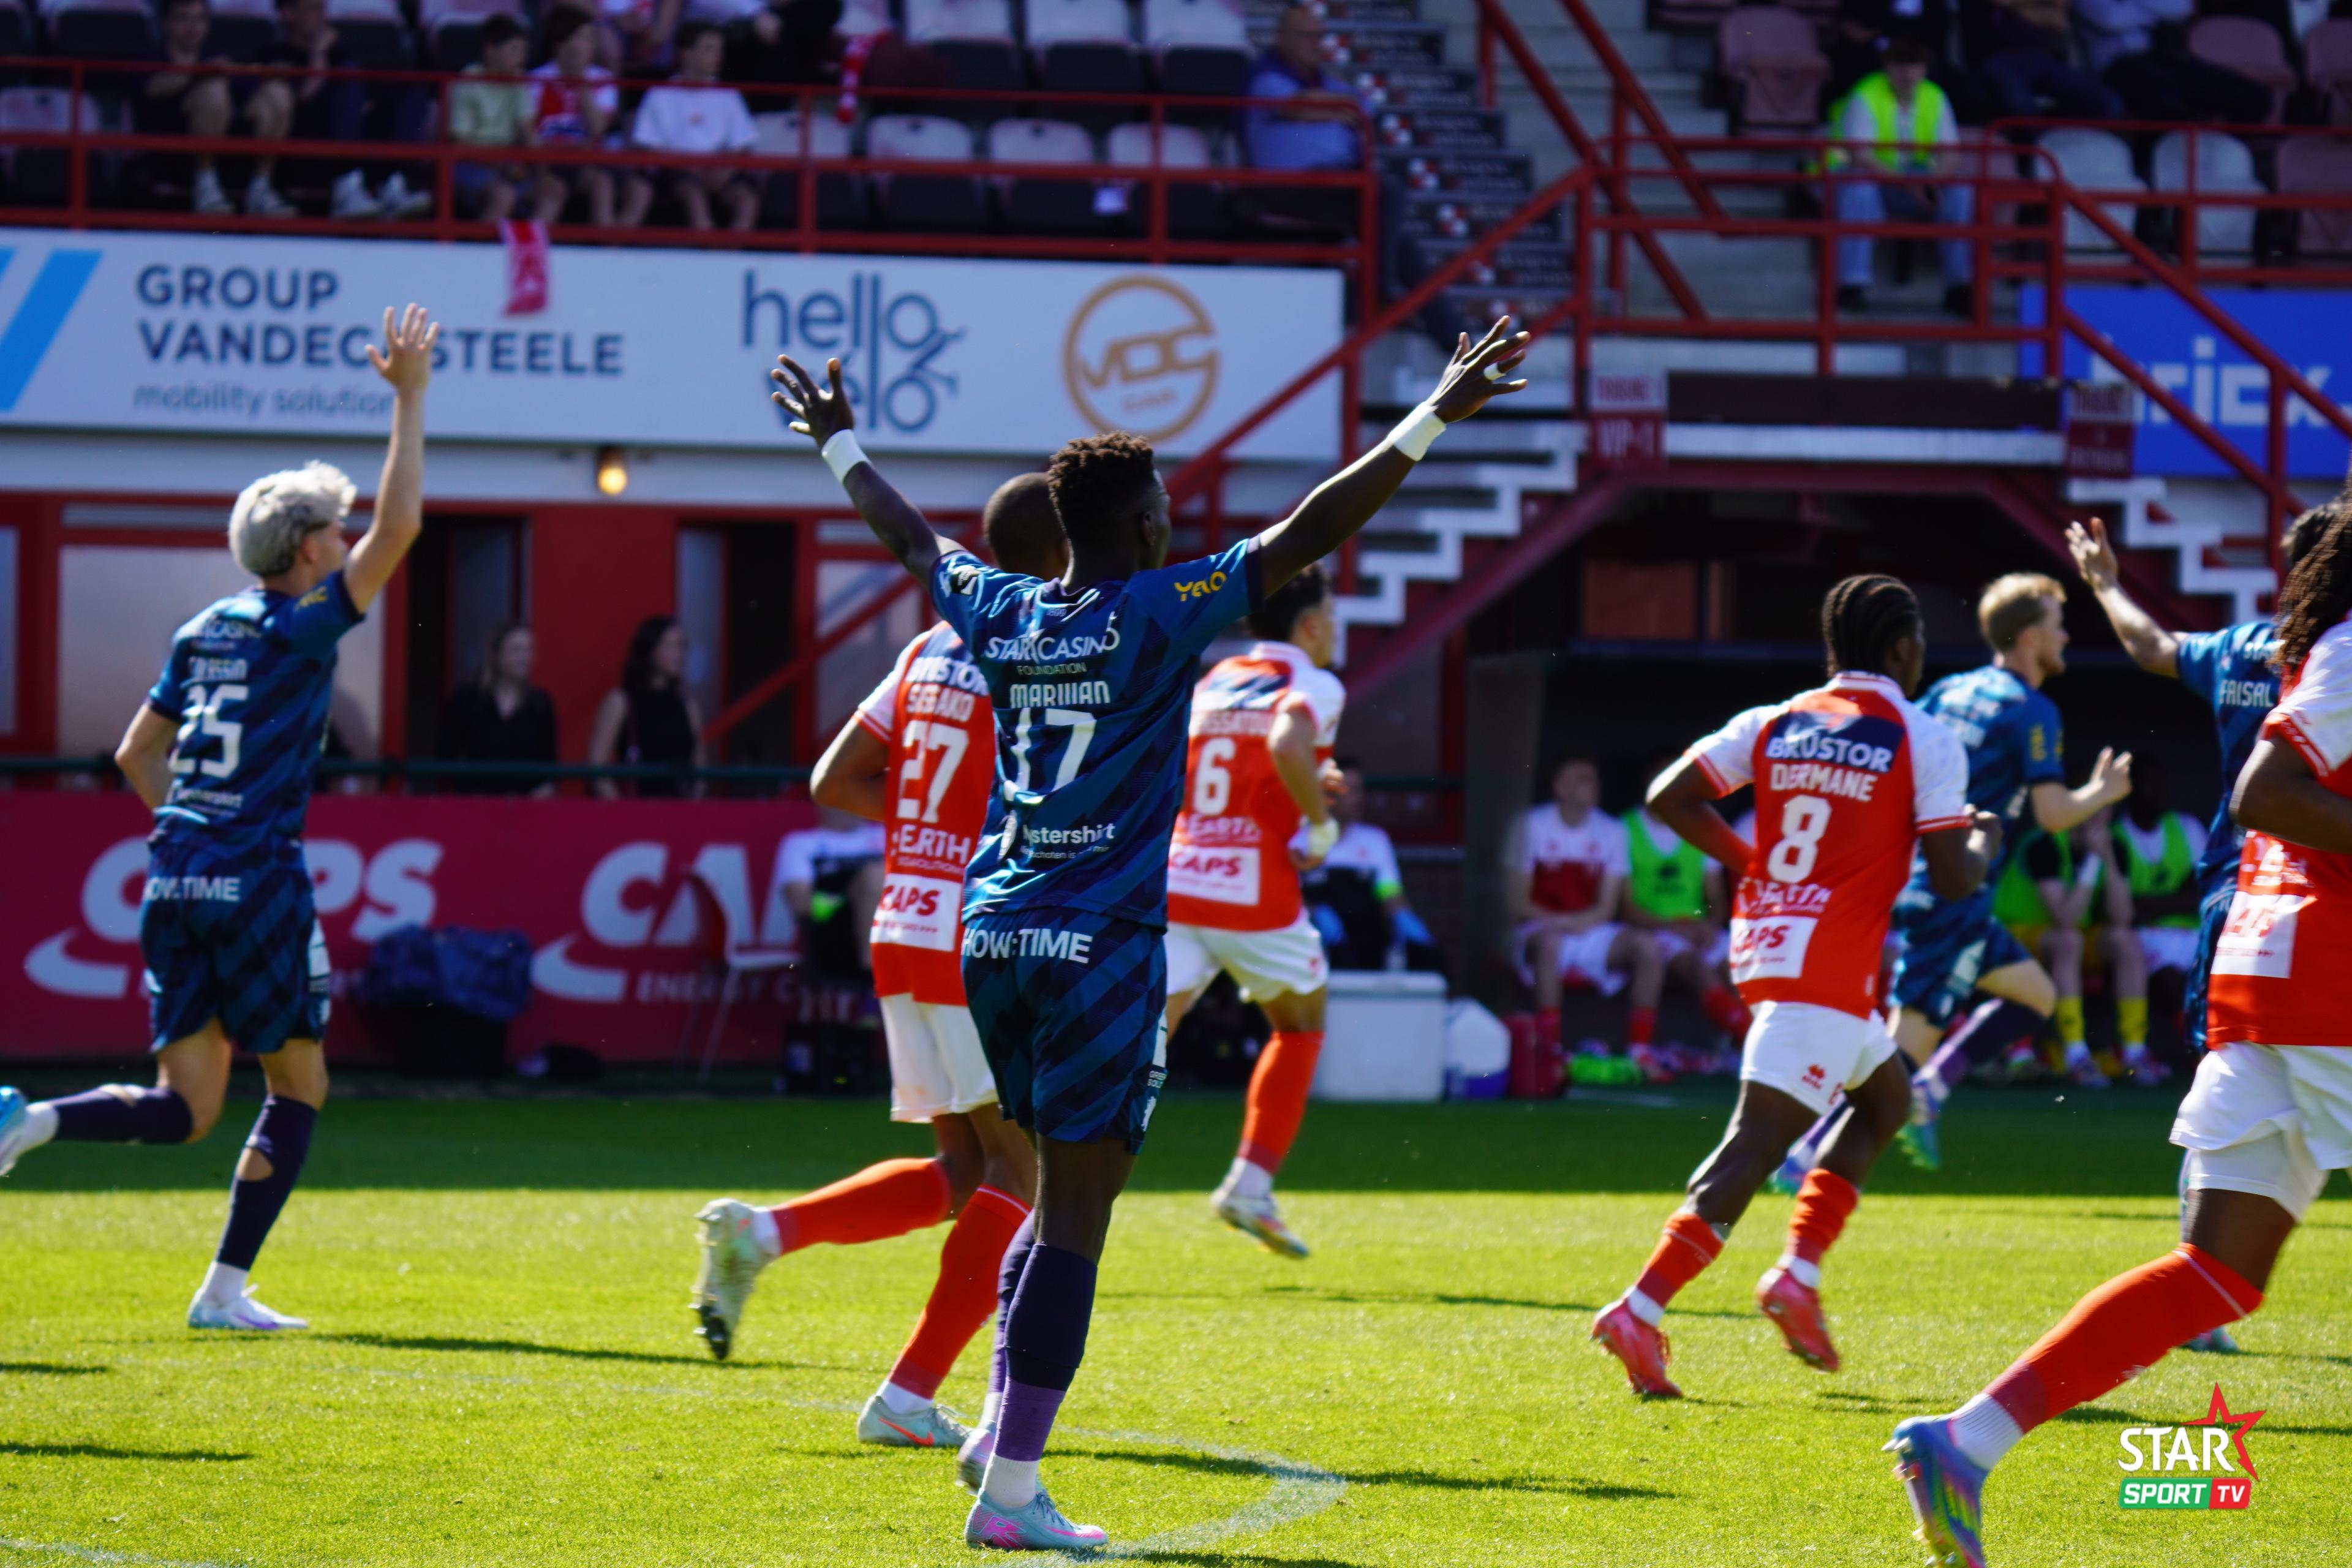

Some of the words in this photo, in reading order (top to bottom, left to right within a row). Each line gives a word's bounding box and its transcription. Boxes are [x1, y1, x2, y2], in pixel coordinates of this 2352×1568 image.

[136, 263, 339, 311] GROUP
[742, 268, 940, 352] hello
[138, 318, 625, 377] VANDECSTEELE
[133, 382, 265, 423] mobility
[272, 385, 396, 416] solution
[1017, 662, 1087, 676] FOUNDATION
[2218, 680, 2275, 708] FAISAL
[168, 683, 250, 778] 25
[1002, 707, 1096, 804] 17
[1765, 734, 1894, 774] BRUSTOR
[896, 720, 970, 824] 27
[1193, 737, 1236, 816] 6
[1770, 763, 1879, 802] DERMANE
[1766, 794, 1833, 884] 8
[81, 837, 443, 943] CPS
